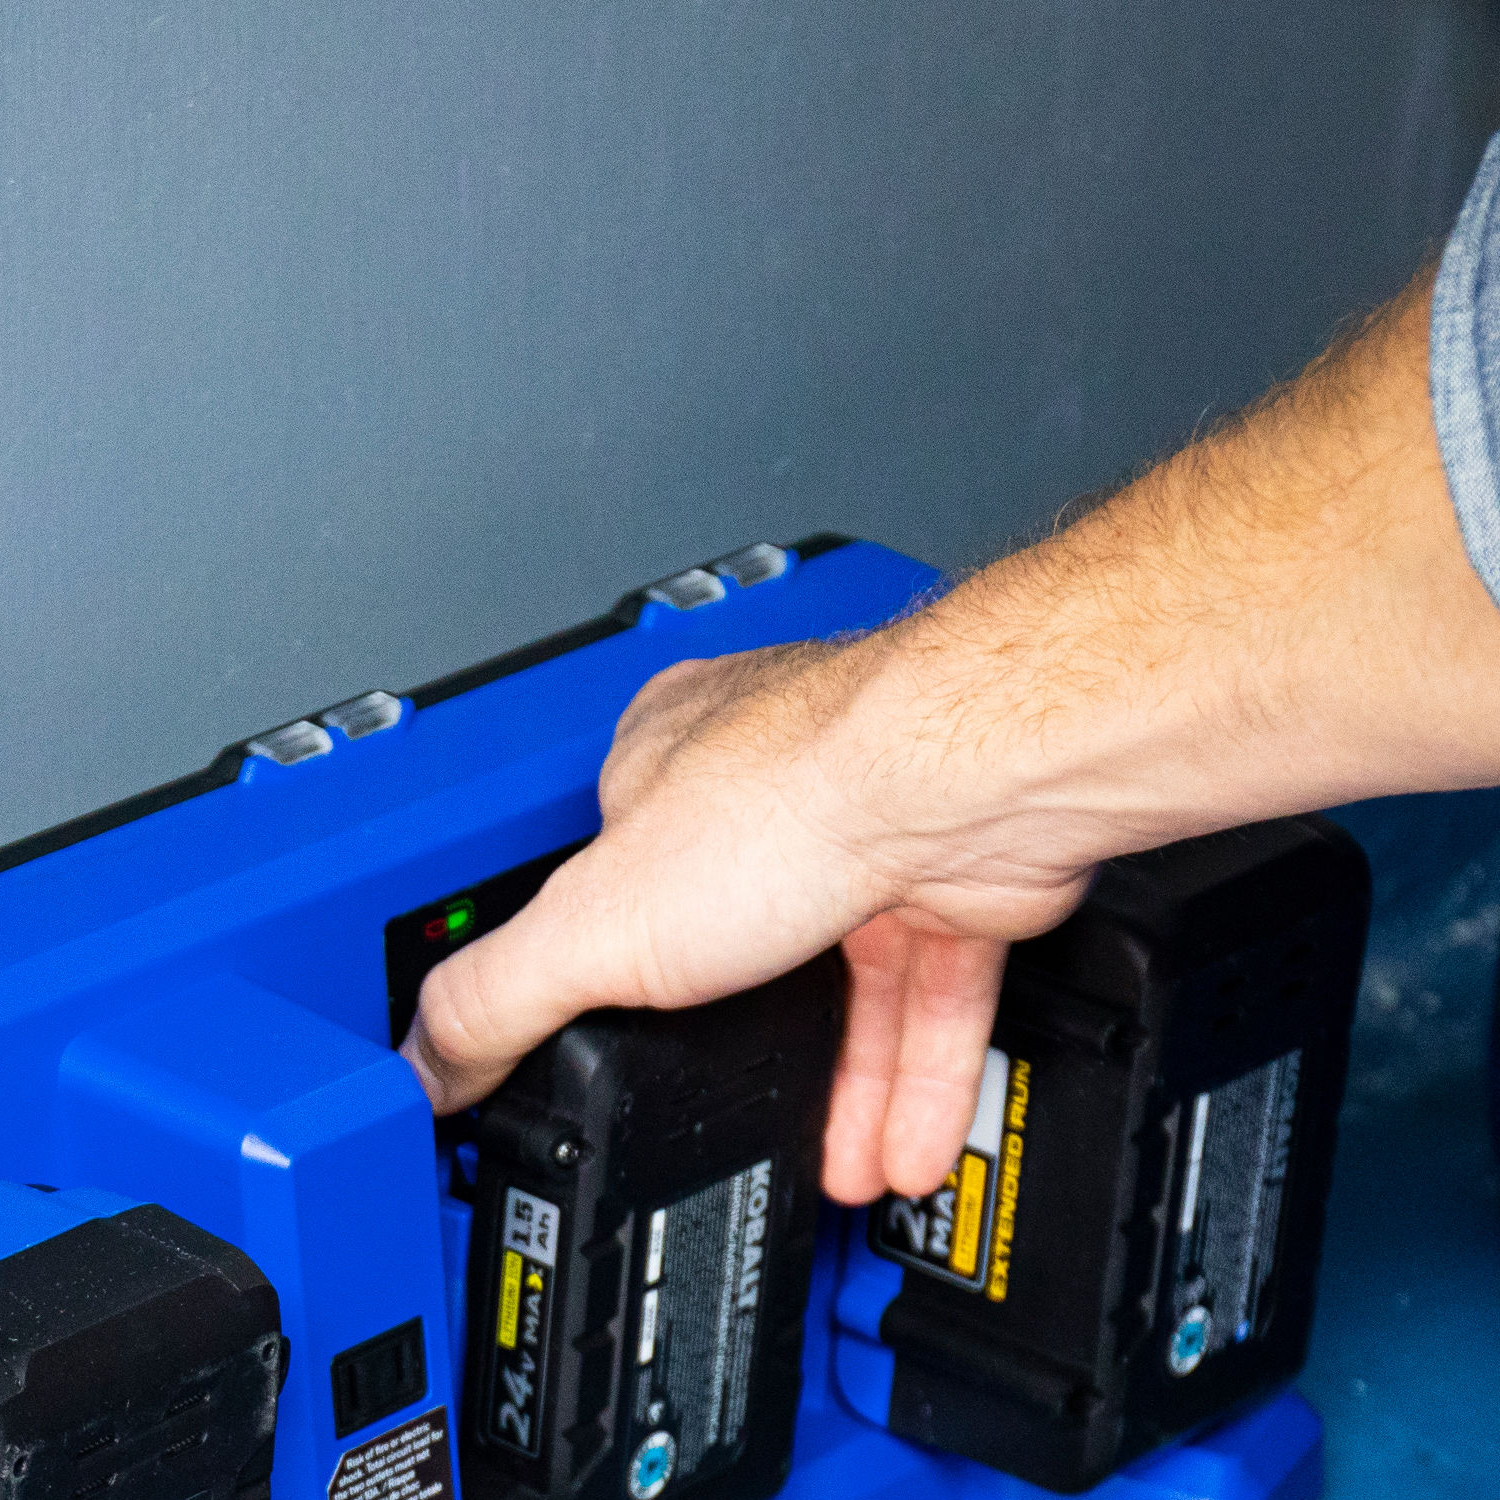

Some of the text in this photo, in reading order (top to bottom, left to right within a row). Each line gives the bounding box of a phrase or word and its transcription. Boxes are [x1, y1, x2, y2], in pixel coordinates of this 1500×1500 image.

[510, 1193, 550, 1250] 1.5 Ah
[738, 1159, 772, 1308] KOBALT
[984, 1059, 1034, 1304] EXTENDED RUN
